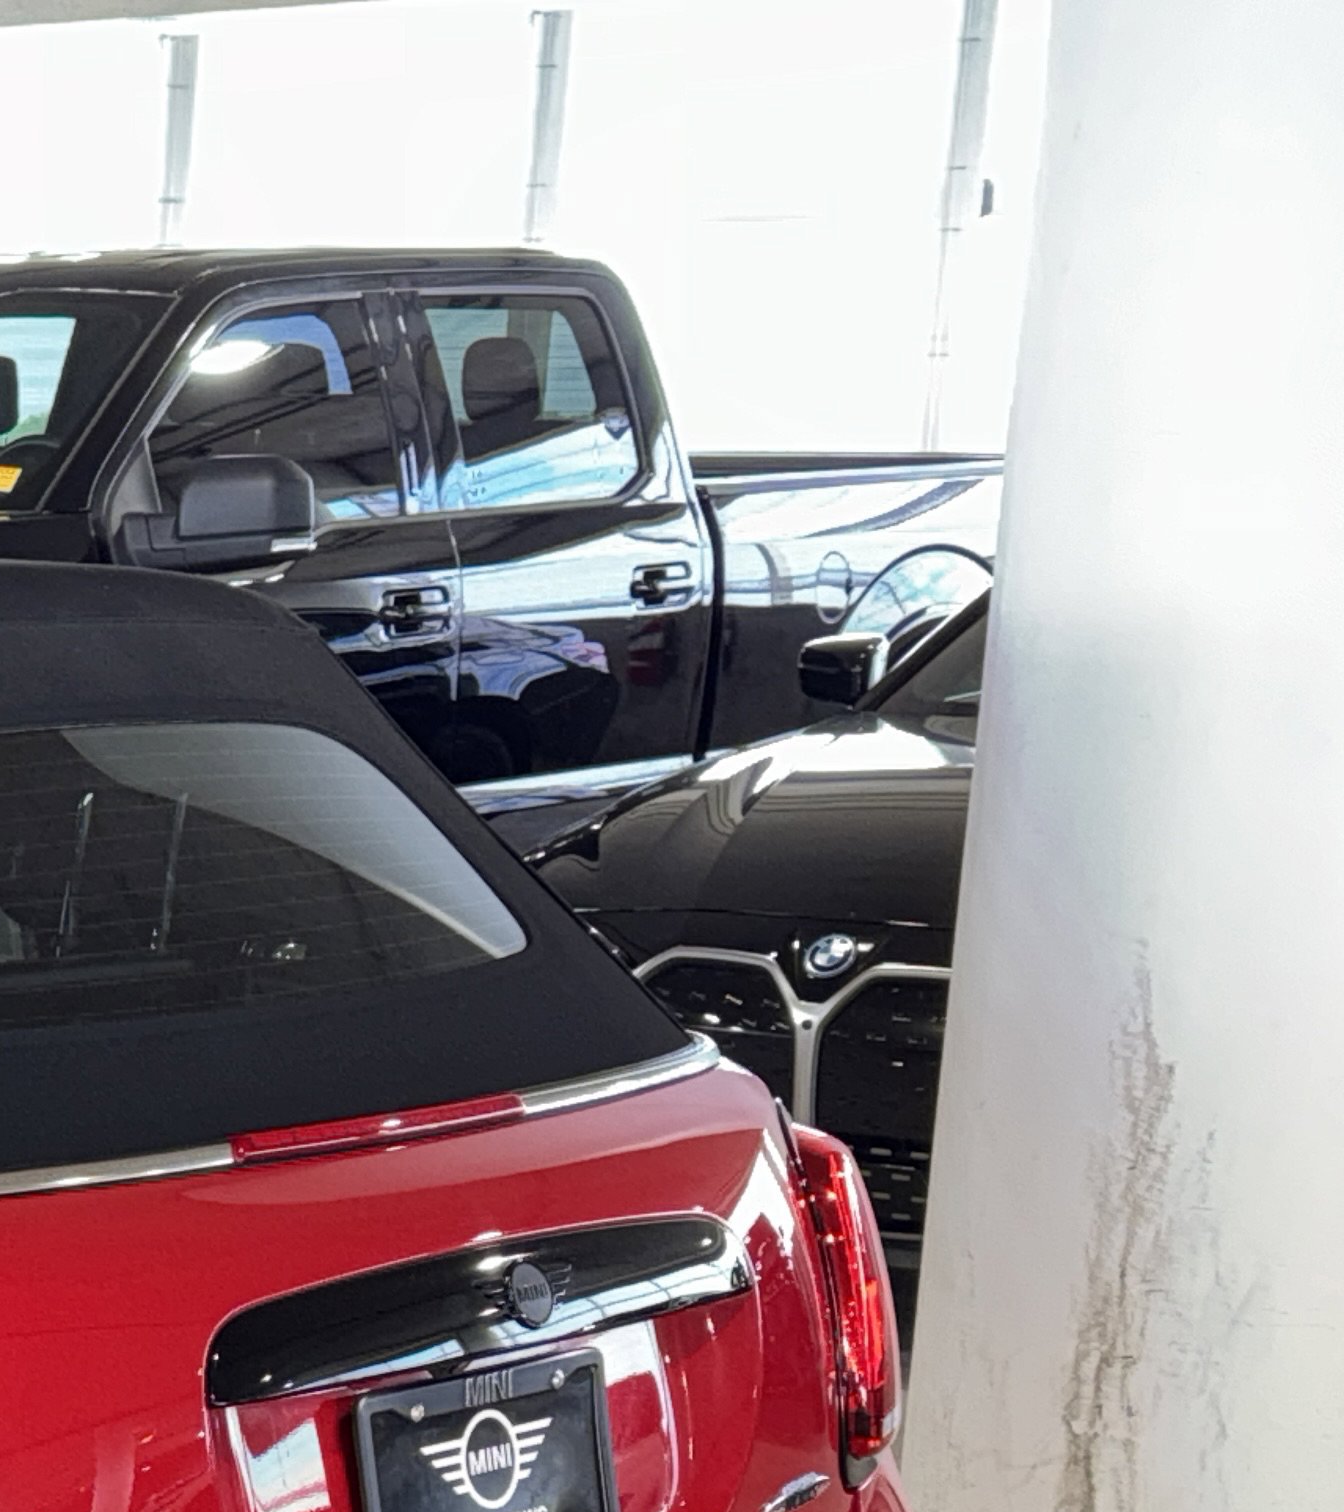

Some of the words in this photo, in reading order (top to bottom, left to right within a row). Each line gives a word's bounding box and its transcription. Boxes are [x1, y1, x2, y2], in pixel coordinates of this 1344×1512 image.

[515, 1283, 550, 1304] MINI
[465, 1369, 513, 1408] MINI
[468, 1442, 513, 1477] MINI
